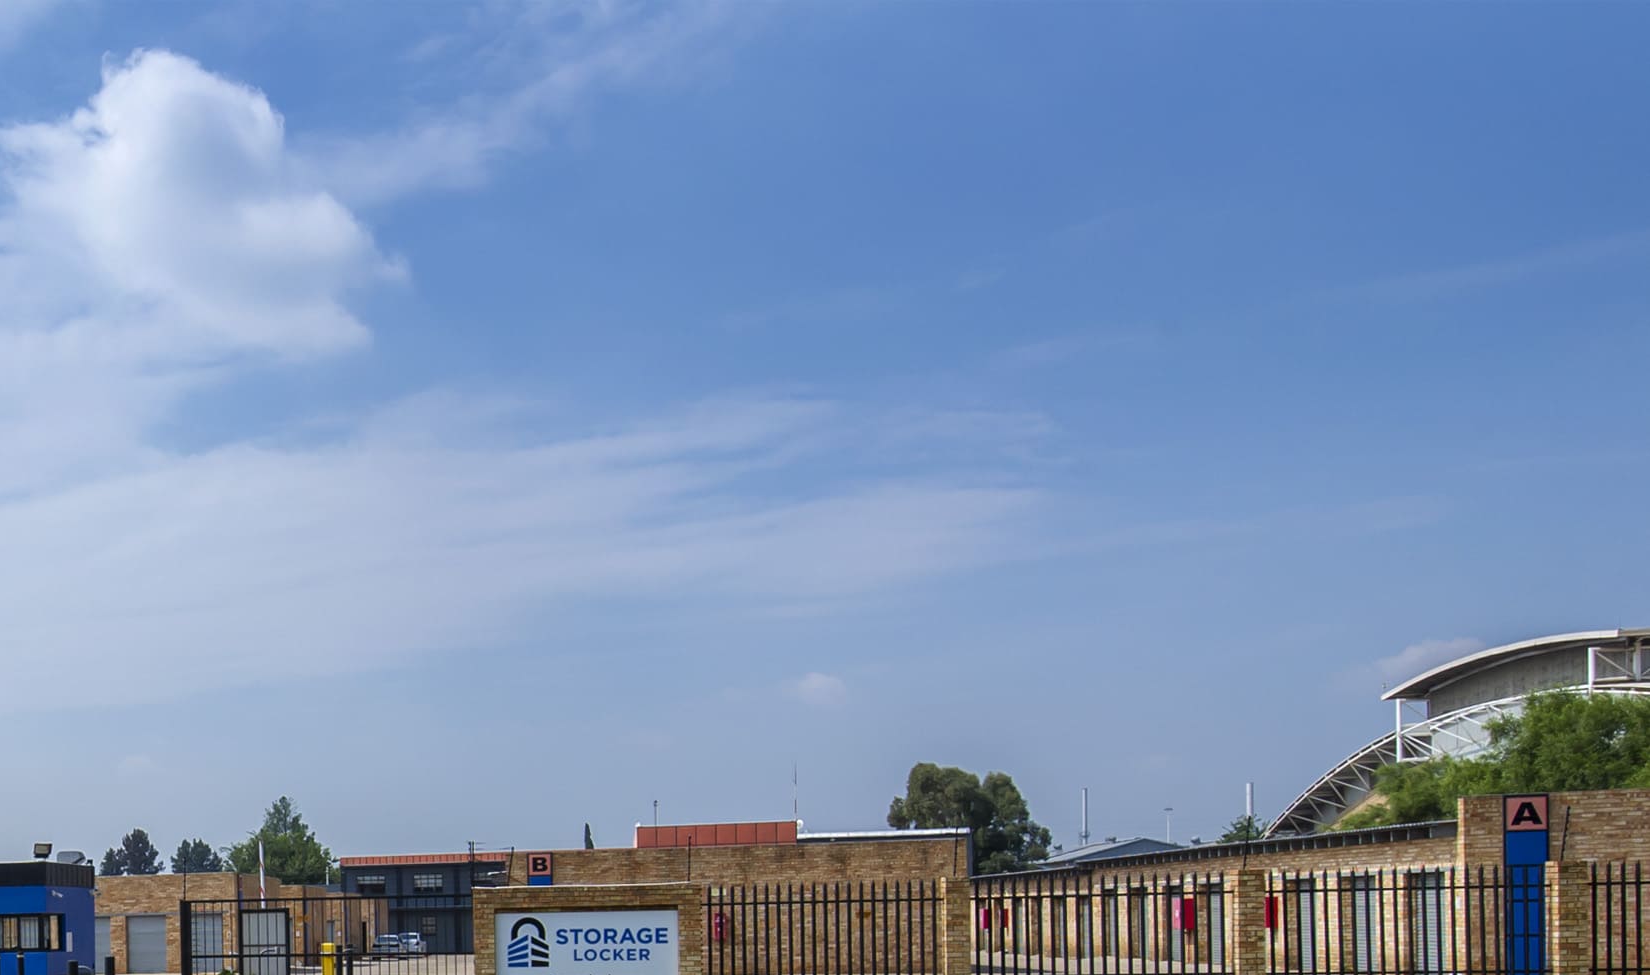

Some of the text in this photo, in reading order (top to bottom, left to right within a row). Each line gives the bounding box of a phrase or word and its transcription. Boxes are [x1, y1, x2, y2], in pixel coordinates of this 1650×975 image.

[1511, 801, 1543, 826] A
[532, 857, 548, 872] B
[555, 927, 669, 945] STORAGE
[573, 948, 651, 962] LOCKER
